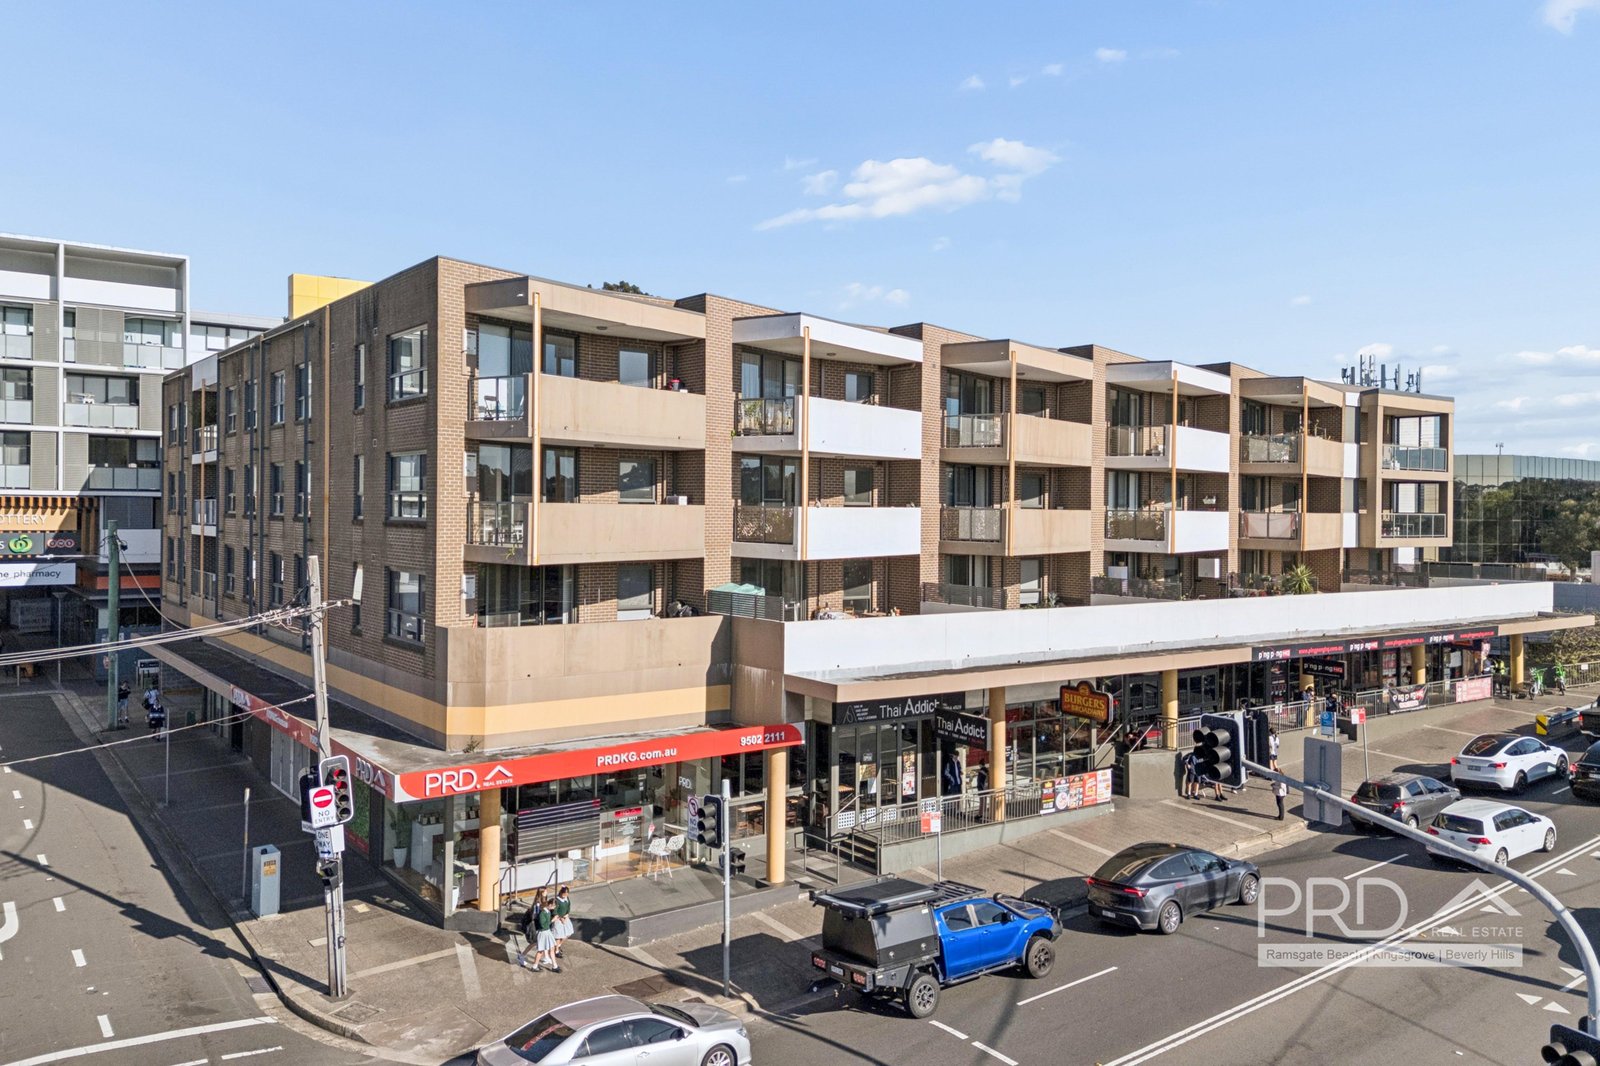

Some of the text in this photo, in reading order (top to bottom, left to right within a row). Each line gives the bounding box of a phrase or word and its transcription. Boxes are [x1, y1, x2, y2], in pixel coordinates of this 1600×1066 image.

[14, 570, 61, 578] pharmacy
[880, 704, 901, 718] Thai
[904, 698, 940, 715] Addict
[1064, 693, 1105, 709] BURGERS
[937, 716, 954, 731] Thai
[955, 718, 985, 739] Addict
[740, 732, 785, 746] 9502 2111
[597, 748, 677, 767] PRDKG.com.au
[318, 810, 330, 818] NO
[317, 831, 329, 839] ONE
